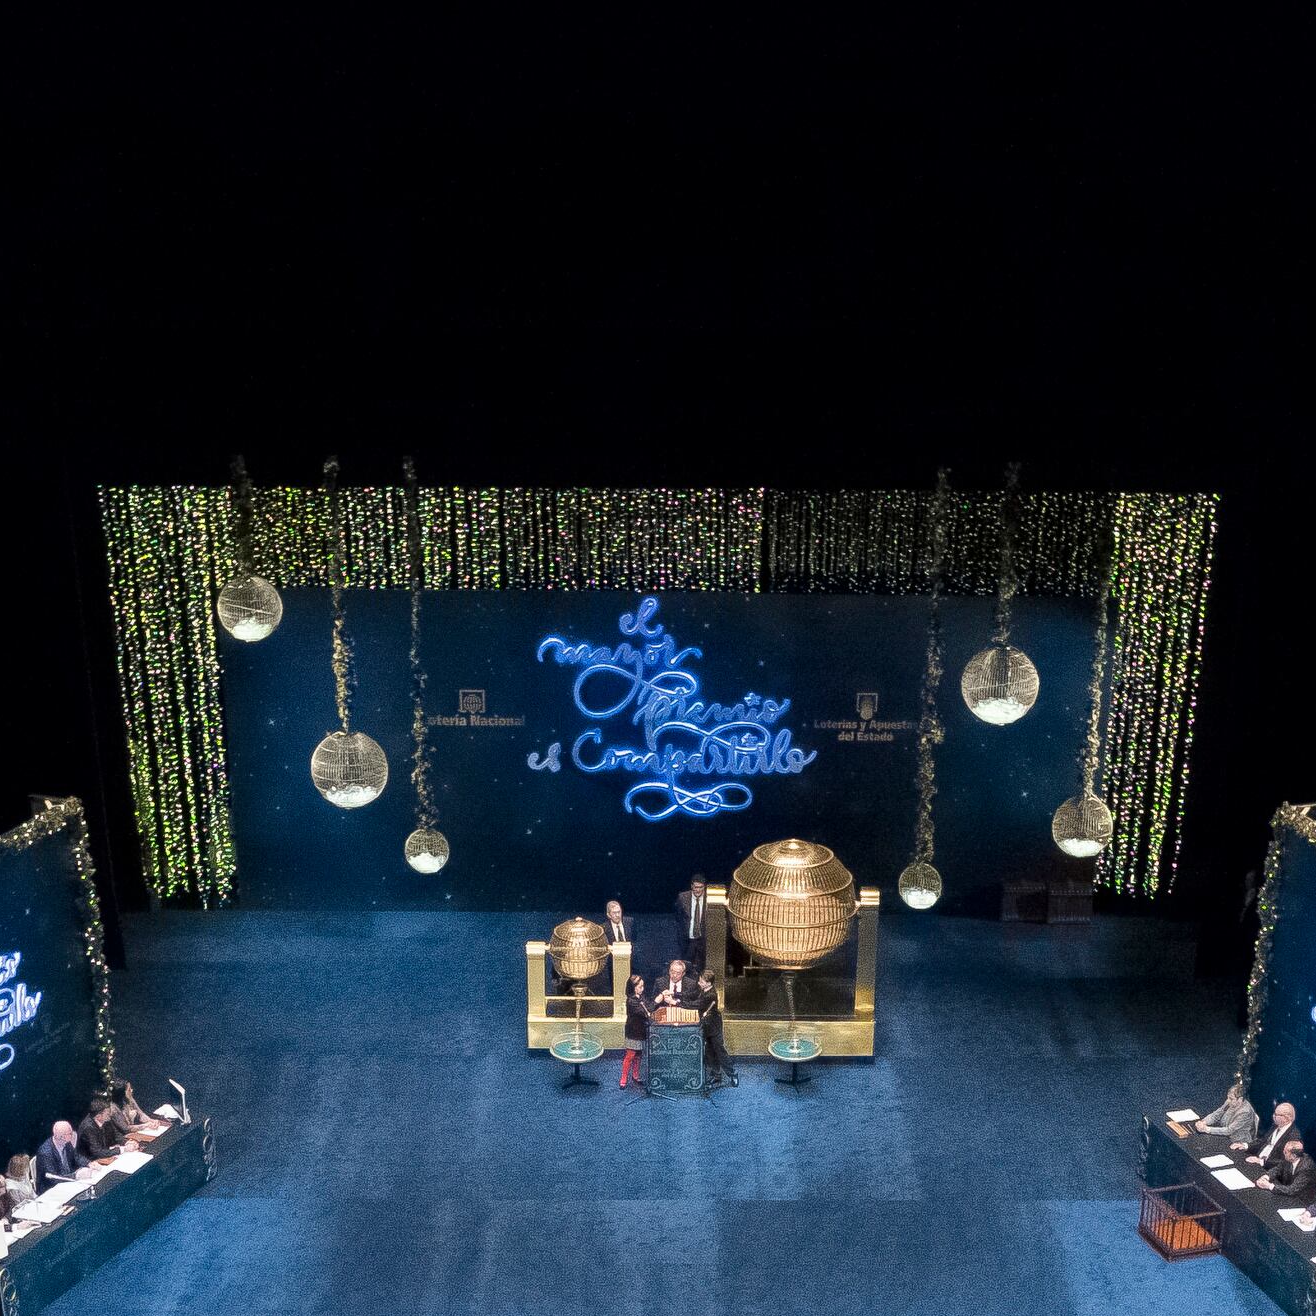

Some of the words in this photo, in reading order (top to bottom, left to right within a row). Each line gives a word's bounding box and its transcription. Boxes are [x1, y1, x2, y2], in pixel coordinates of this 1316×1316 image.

[619, 597, 663, 636] el
[536, 634, 702, 719] mayor
[470, 714, 525, 726] Nacional
[860, 721, 867, 731] y
[838, 731, 854, 741] del
[857, 731, 894, 741] Estado
[527, 742, 561, 772] es
